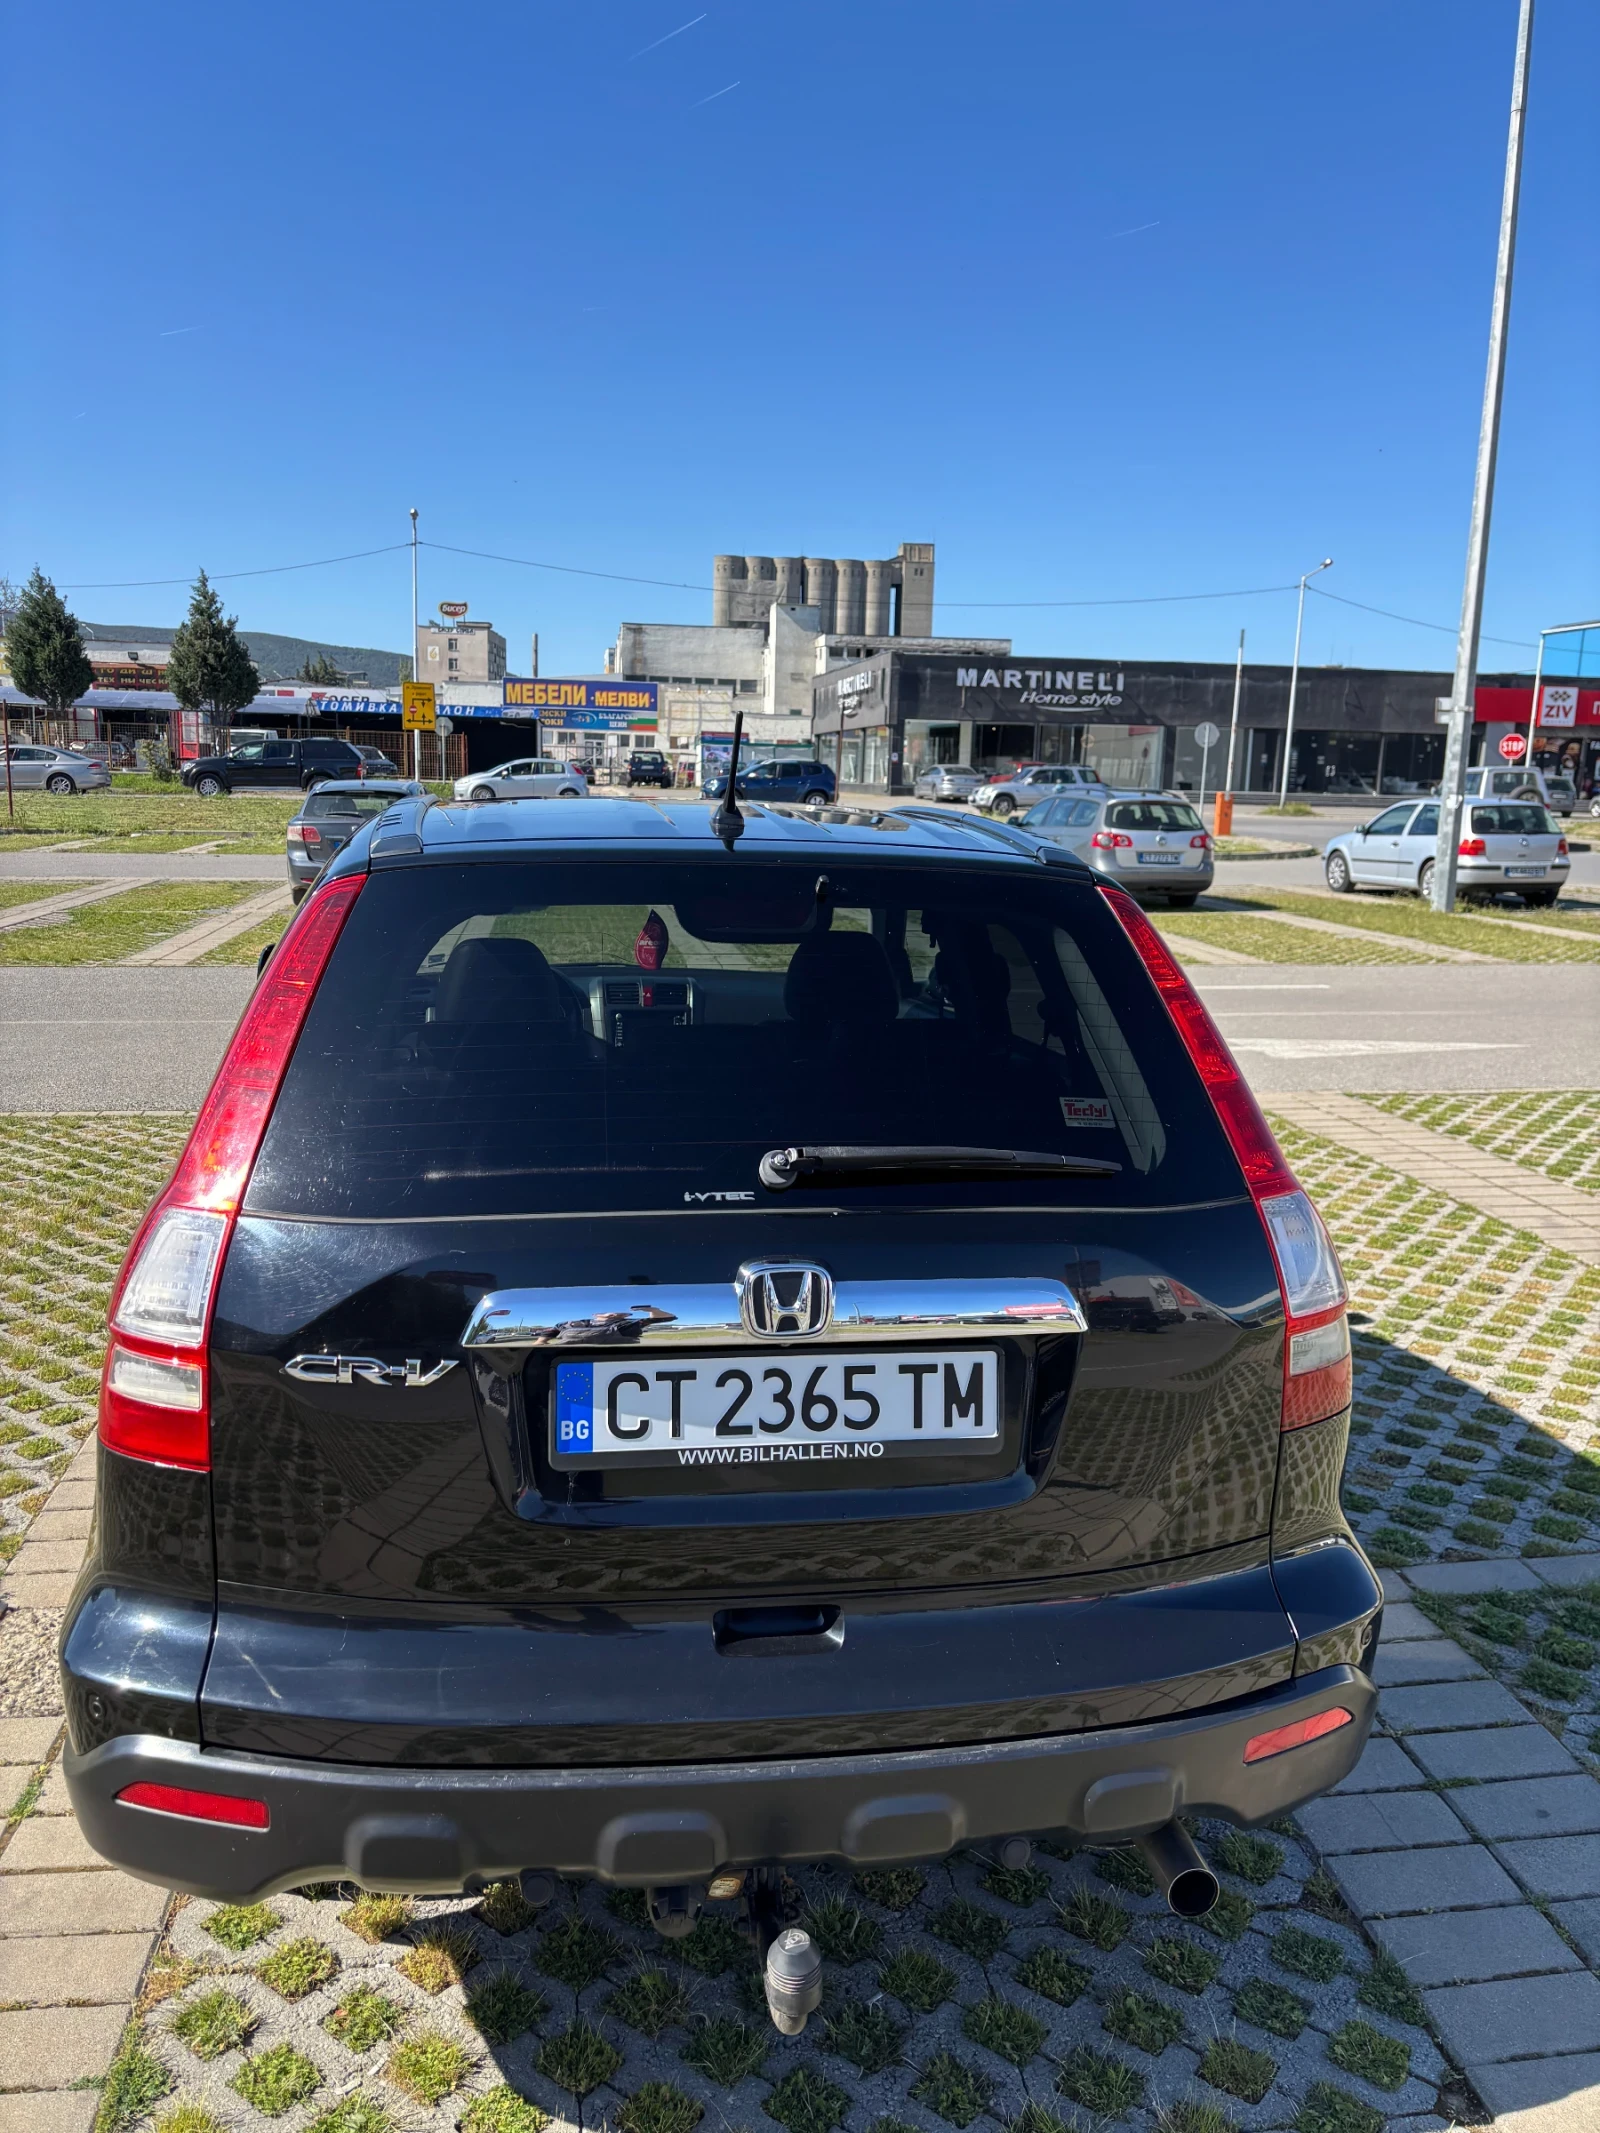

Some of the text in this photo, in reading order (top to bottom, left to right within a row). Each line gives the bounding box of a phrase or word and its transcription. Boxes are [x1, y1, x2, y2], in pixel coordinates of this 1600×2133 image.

[956, 668, 1125, 692] MARTINELI
[505, 682, 650, 708] МЕБЕЛИ МЕЛВИ
[1019, 691, 1123, 707] Home style
[320, 701, 475, 716] ТОМИВКА АЛОН
[1544, 705, 1573, 718] ZIV
[1502, 741, 1525, 752] STOP
[1064, 1103, 1107, 1117] Tectyl
[283, 1354, 460, 1386] CR-V
[607, 1362, 984, 1440] CT 2365 TM
[560, 1420, 589, 1440] BG
[678, 1442, 884, 1464] WWW.BILHALLEN.NO
